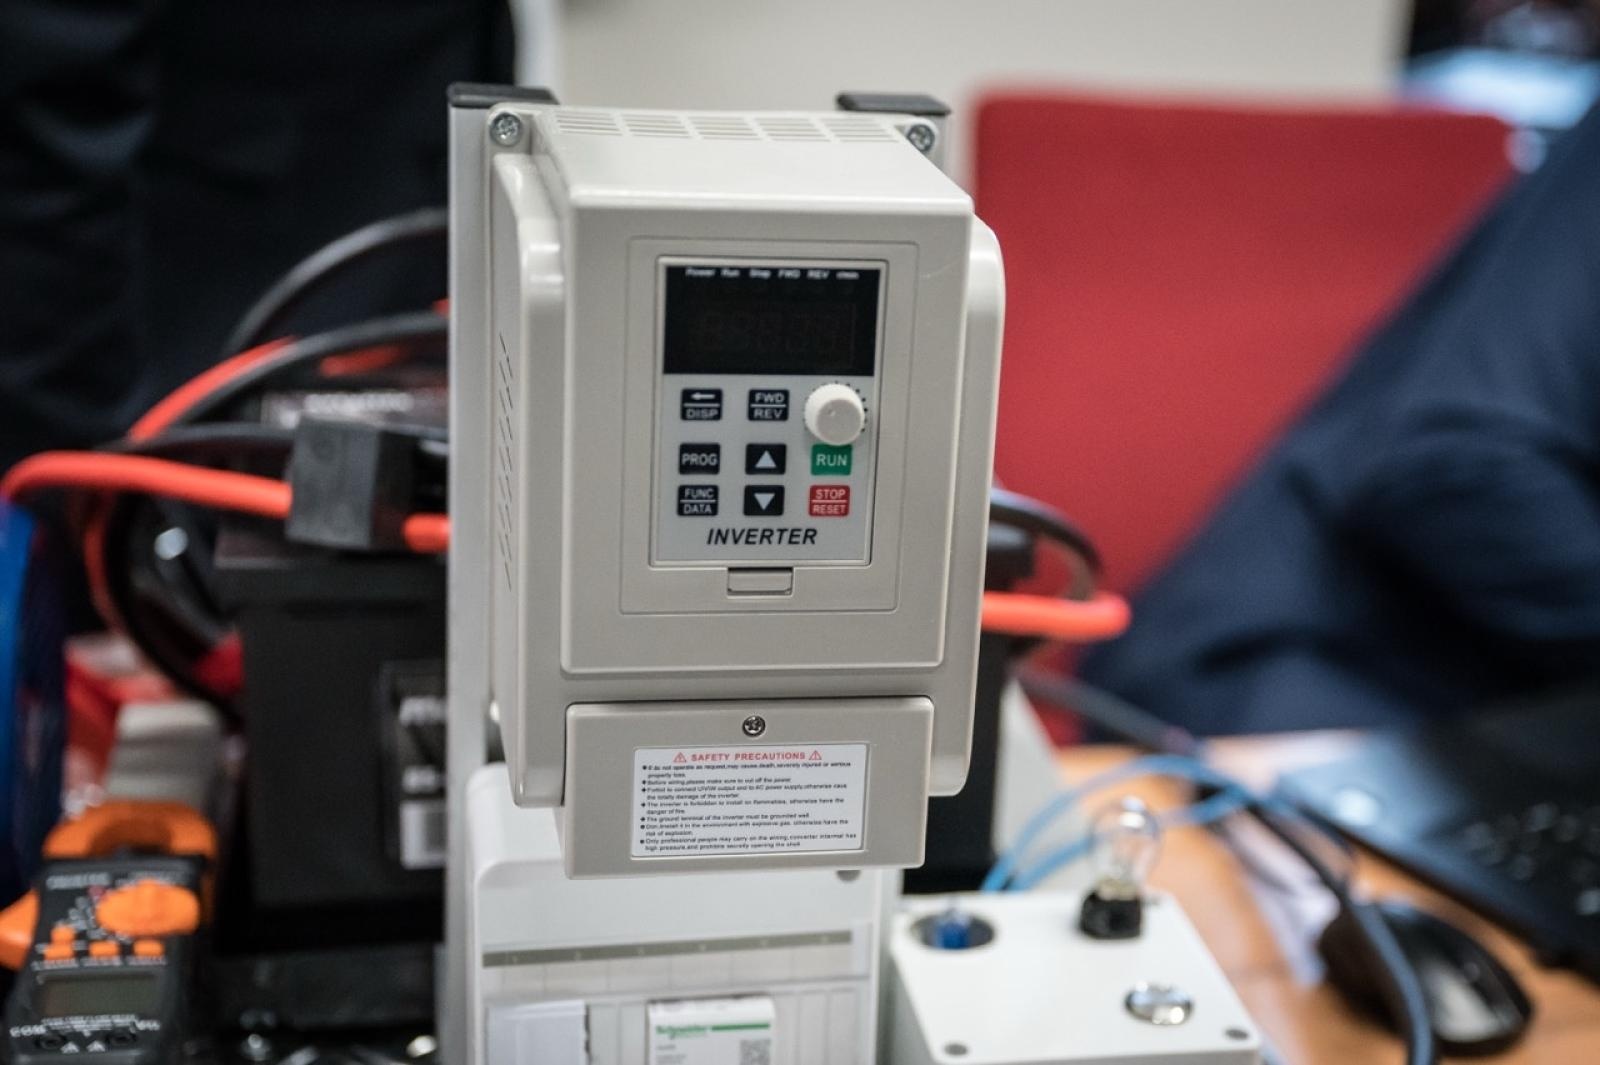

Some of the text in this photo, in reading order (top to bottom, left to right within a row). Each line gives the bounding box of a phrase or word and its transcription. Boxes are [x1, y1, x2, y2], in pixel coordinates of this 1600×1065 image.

[778, 269, 801, 279] FWD
[806, 270, 830, 279] REV
[754, 393, 785, 403] FWD
[686, 409, 718, 419] DISP
[754, 409, 782, 419] REV
[682, 453, 718, 466] PROG
[816, 454, 848, 466] RUN
[684, 488, 714, 498] FUNC
[816, 489, 846, 500] STOP
[684, 504, 712, 514] DATA
[812, 504, 846, 514] RESET
[706, 528, 817, 545] INVERTER
[691, 752, 806, 762] SAFETY PRECAUTIONS
